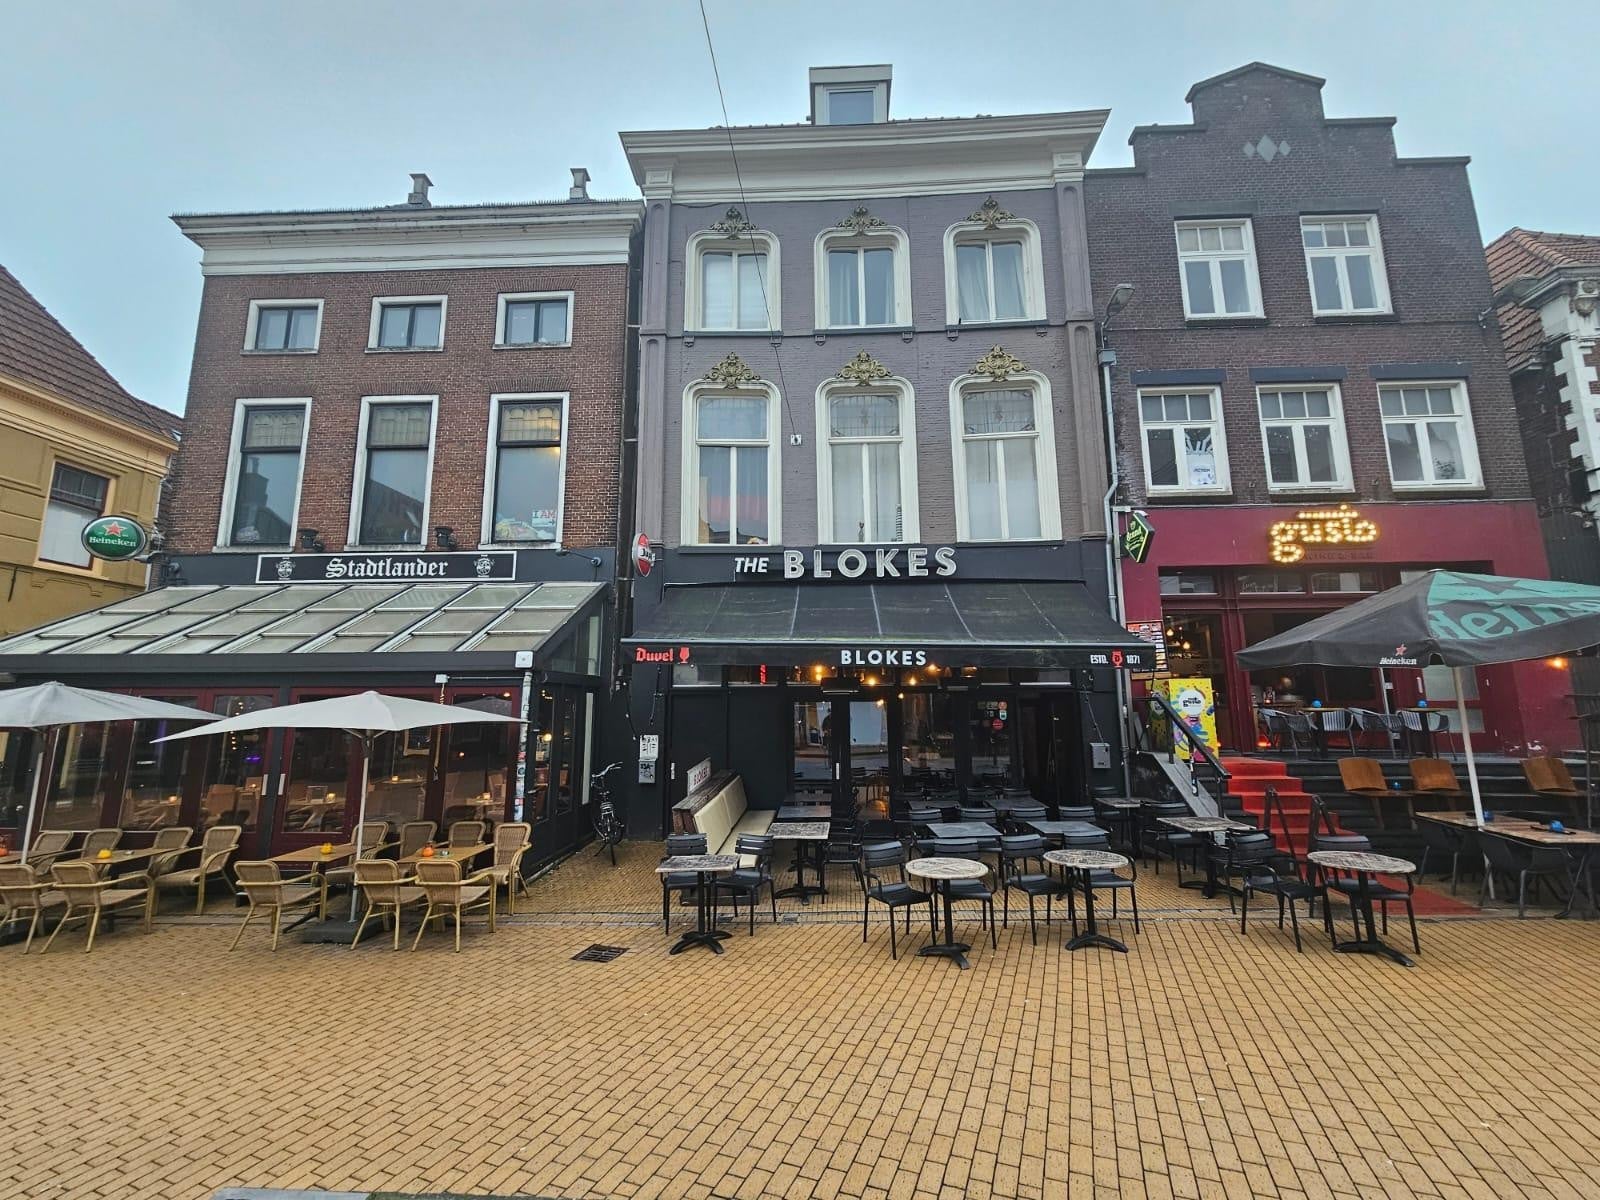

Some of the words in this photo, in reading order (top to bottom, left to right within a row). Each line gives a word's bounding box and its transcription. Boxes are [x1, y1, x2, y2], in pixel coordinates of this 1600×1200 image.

[89, 536, 136, 547] Heineken
[1270, 518, 1377, 563] gusto
[325, 557, 449, 578] Stadtlander
[735, 557, 769, 573] THE
[783, 547, 957, 579] BLOKES
[636, 647, 674, 662] Duvel
[841, 649, 927, 666] BLOKES
[1126, 654, 1141, 665] 1871
[1379, 656, 1418, 665] Heineken
